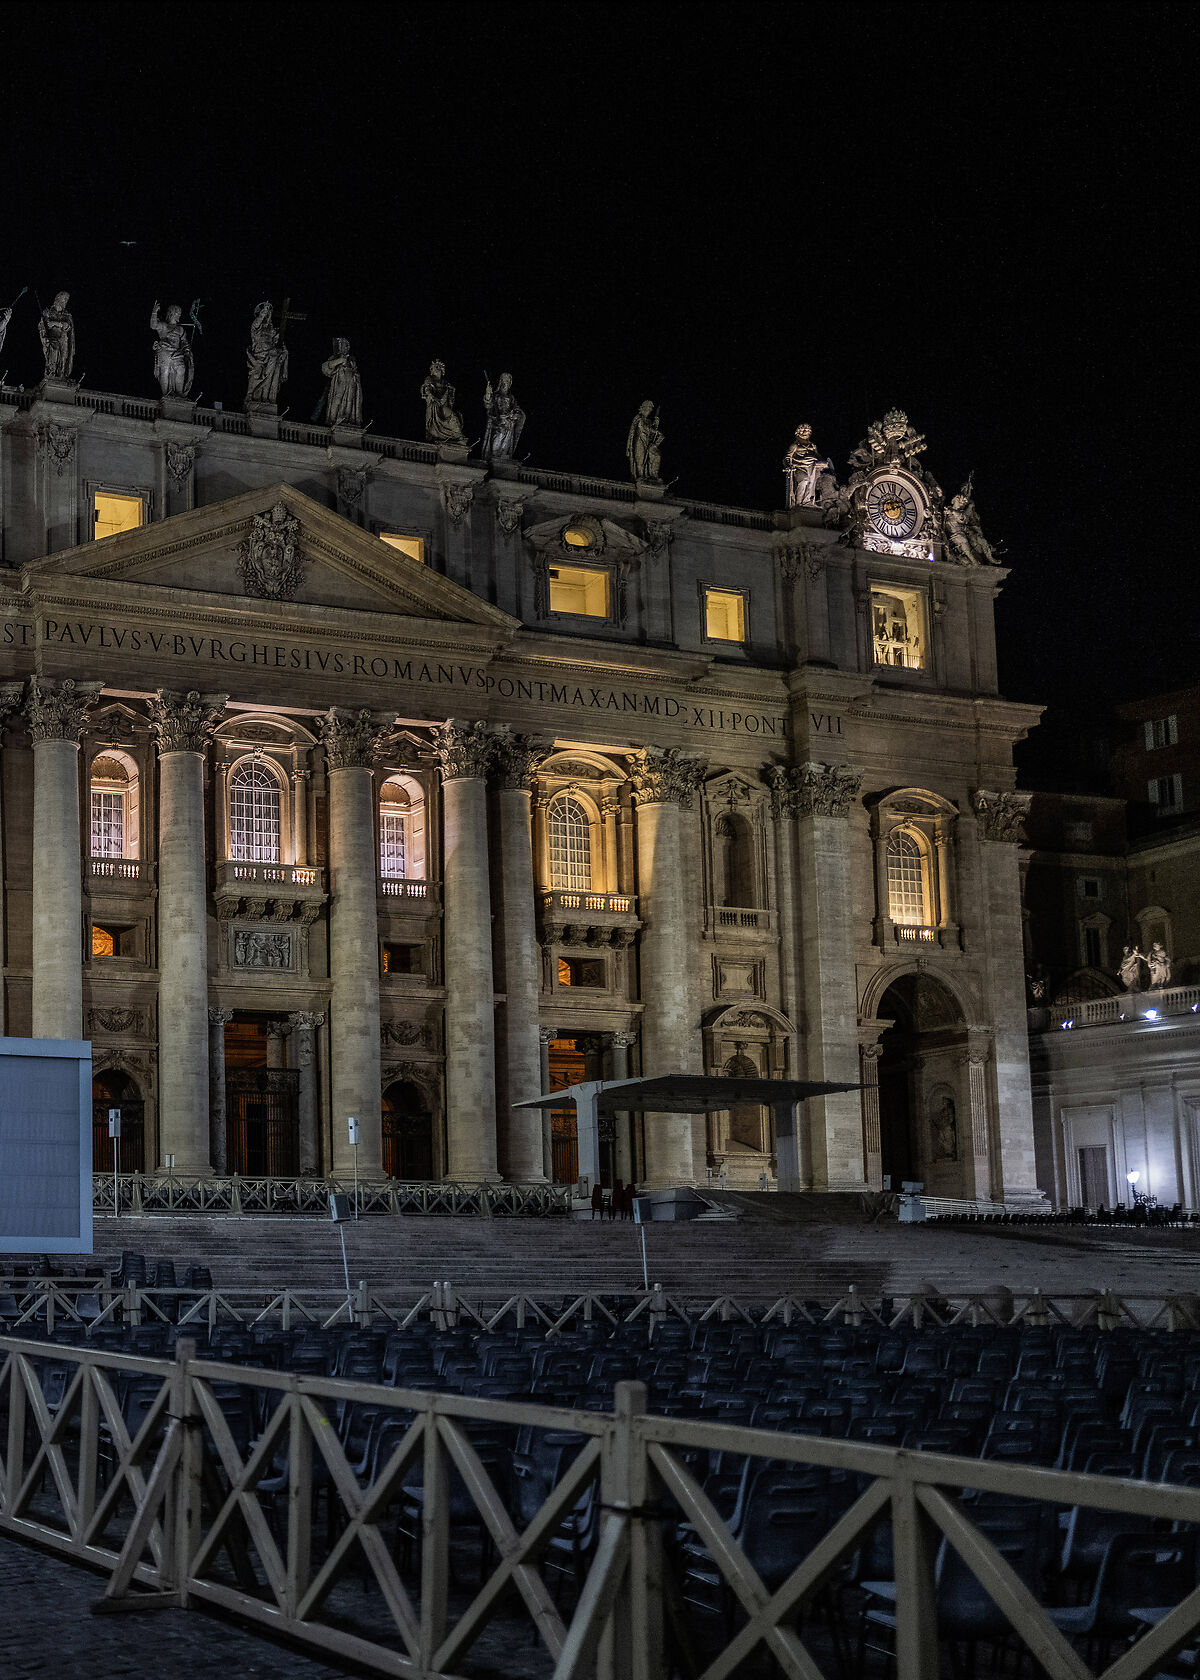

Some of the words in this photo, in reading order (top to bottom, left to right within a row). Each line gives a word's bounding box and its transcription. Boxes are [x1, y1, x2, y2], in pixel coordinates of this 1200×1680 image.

[44, 619, 143, 652] PAVLVS
[172, 633, 344, 673] BVRGHESIVS
[352, 655, 486, 688] ROMANVS
[810, 713, 843, 736] VII
